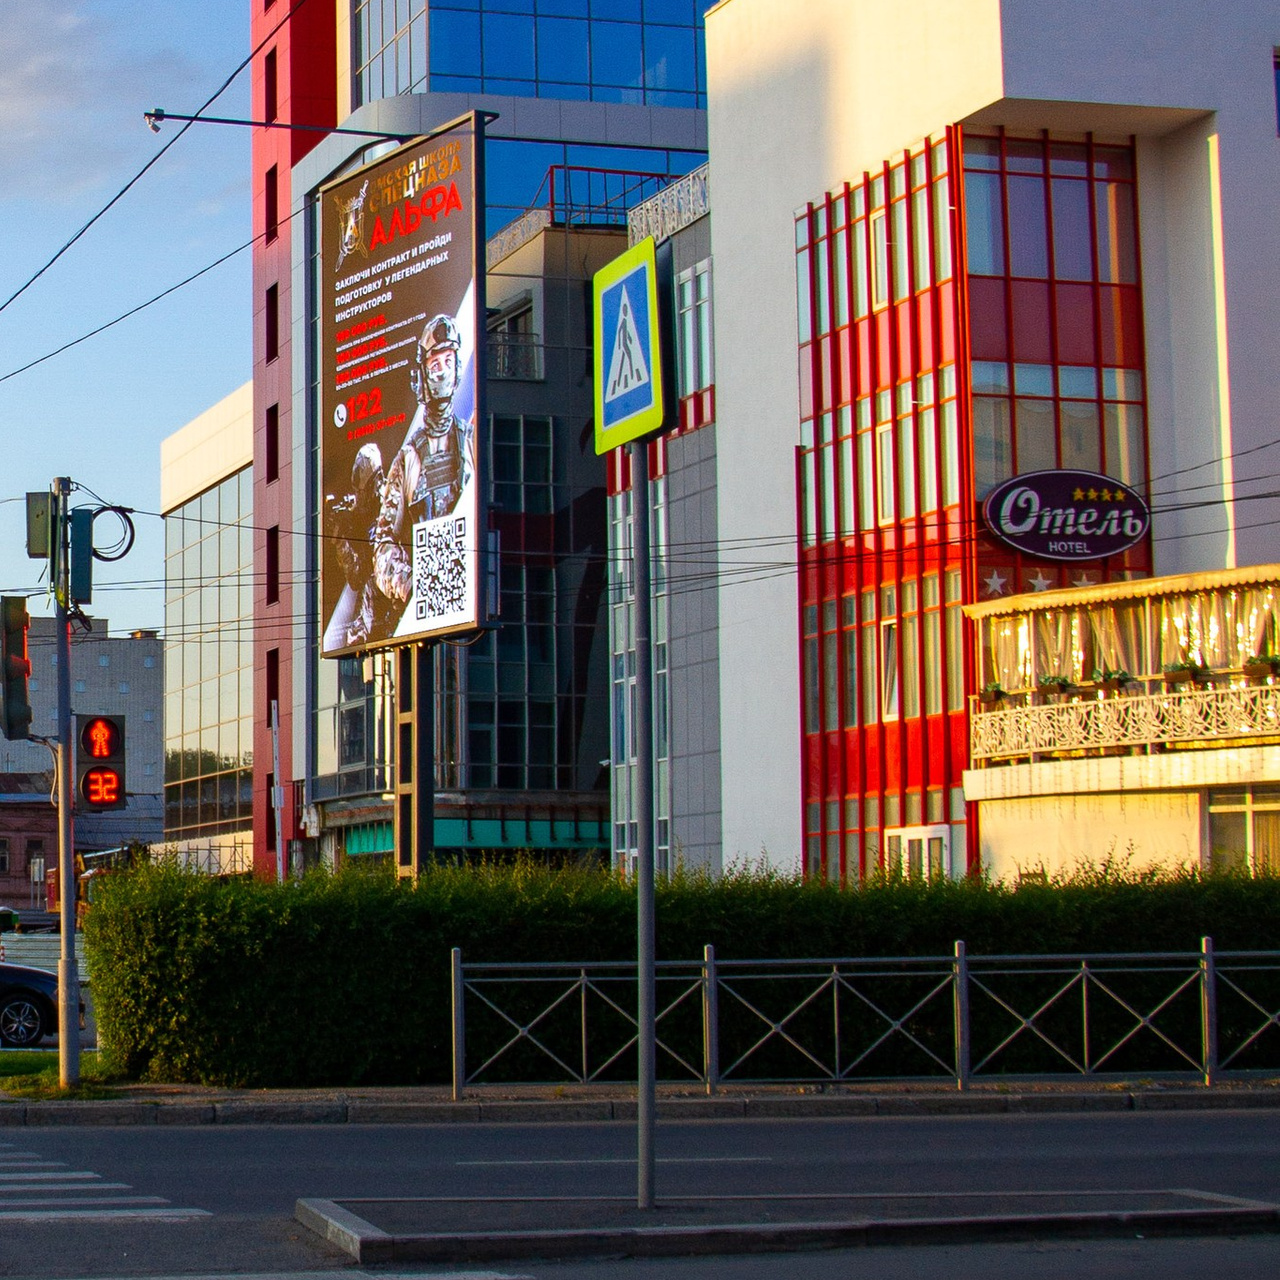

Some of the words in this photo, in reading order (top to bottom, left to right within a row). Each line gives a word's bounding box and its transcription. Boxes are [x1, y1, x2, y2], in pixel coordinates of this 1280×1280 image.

[418, 139, 462, 170] ШКОЛА
[369, 154, 462, 213] СПЕЦНАЗА
[369, 180, 464, 251] АЛЬФА
[335, 268, 371, 291] ЗАКЛЮЧИ
[371, 250, 411, 276] КОНТРАКТ
[411, 246, 418, 258] И
[418, 232, 452, 255] ПРОЙДИ
[335, 278, 383, 307] ПОДГОТОВКУ
[385, 276, 392, 287] У
[391, 251, 449, 284] ЛЕГЕНДАРНЫХ
[335, 291, 393, 323] ИНСТРУКТОРОВ
[346, 387, 383, 423] 122
[1000, 486, 1143, 537] Отель
[1048, 541, 1091, 554] HOTEL
[89, 772, 118, 802] 32
